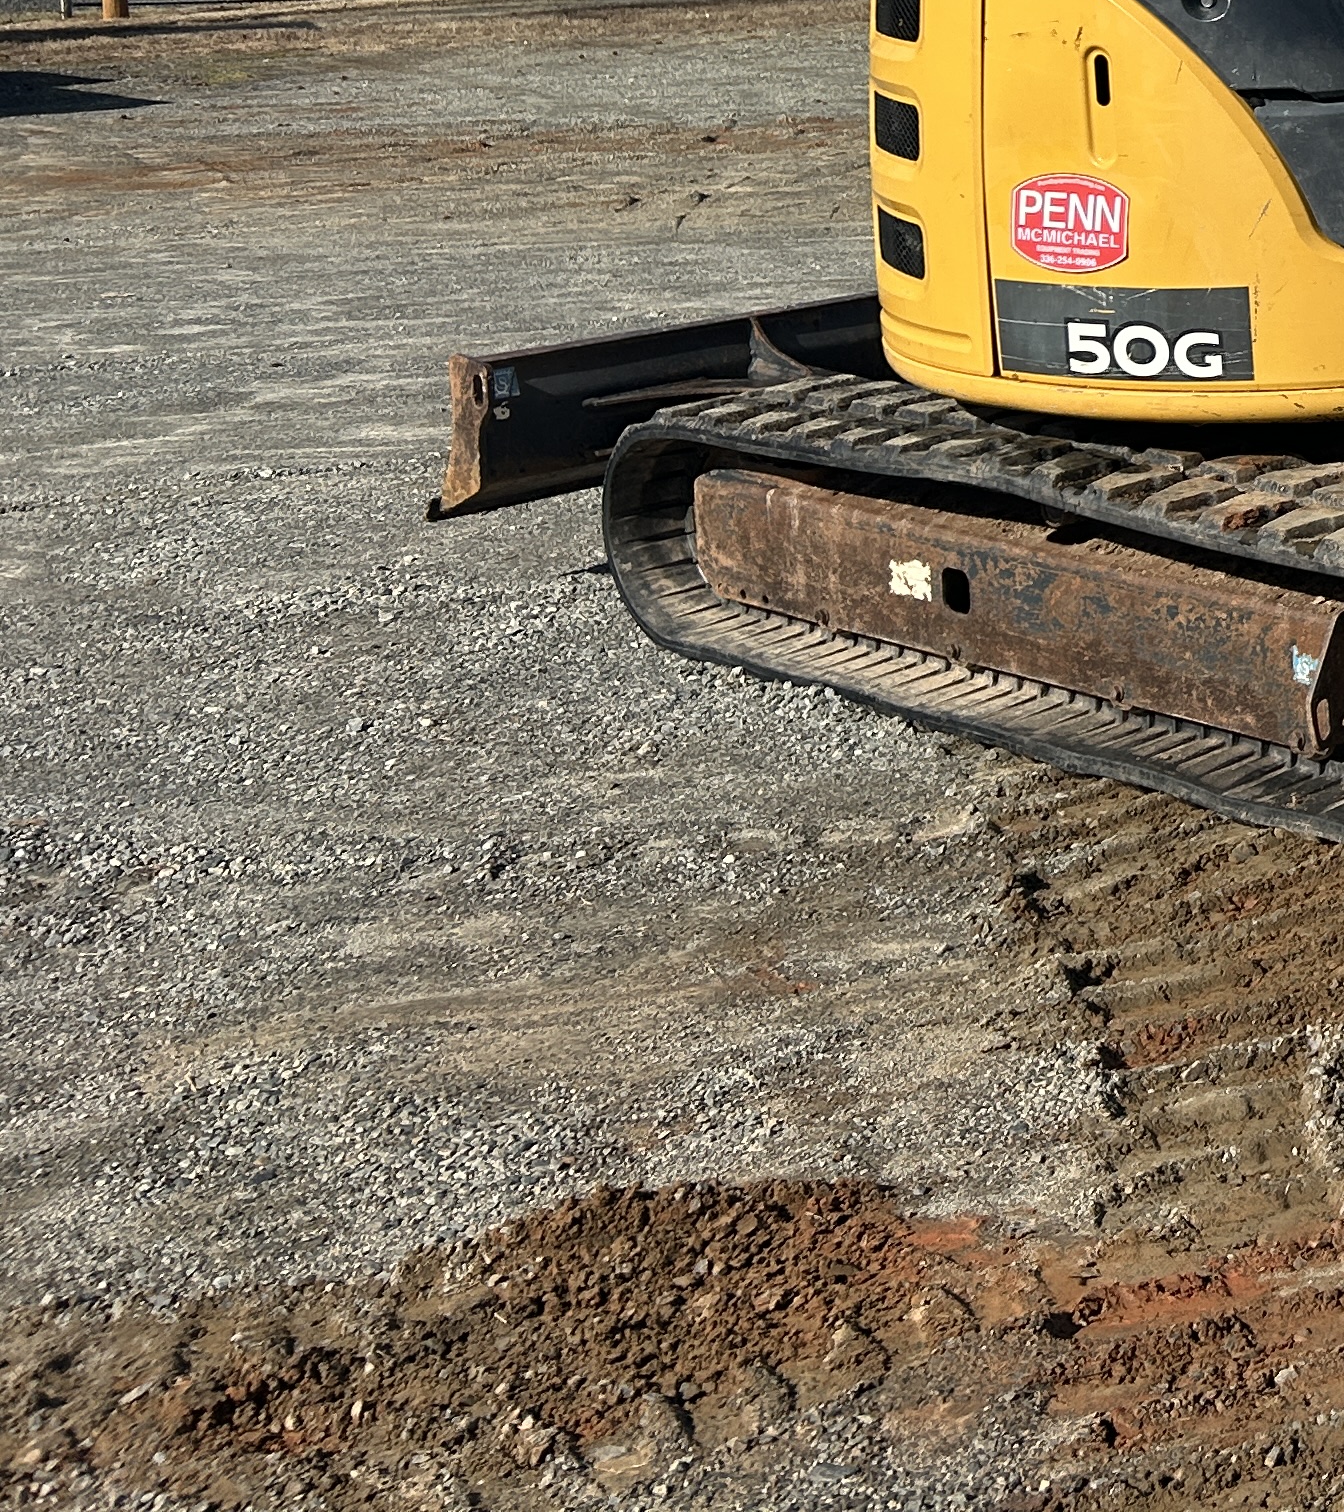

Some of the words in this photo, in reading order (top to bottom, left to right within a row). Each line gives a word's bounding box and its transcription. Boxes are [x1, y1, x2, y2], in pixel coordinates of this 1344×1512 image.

[1018, 189, 1122, 233] PENN
[1017, 227, 1121, 248] MCMICHAEL
[1067, 321, 1223, 379] 50G
